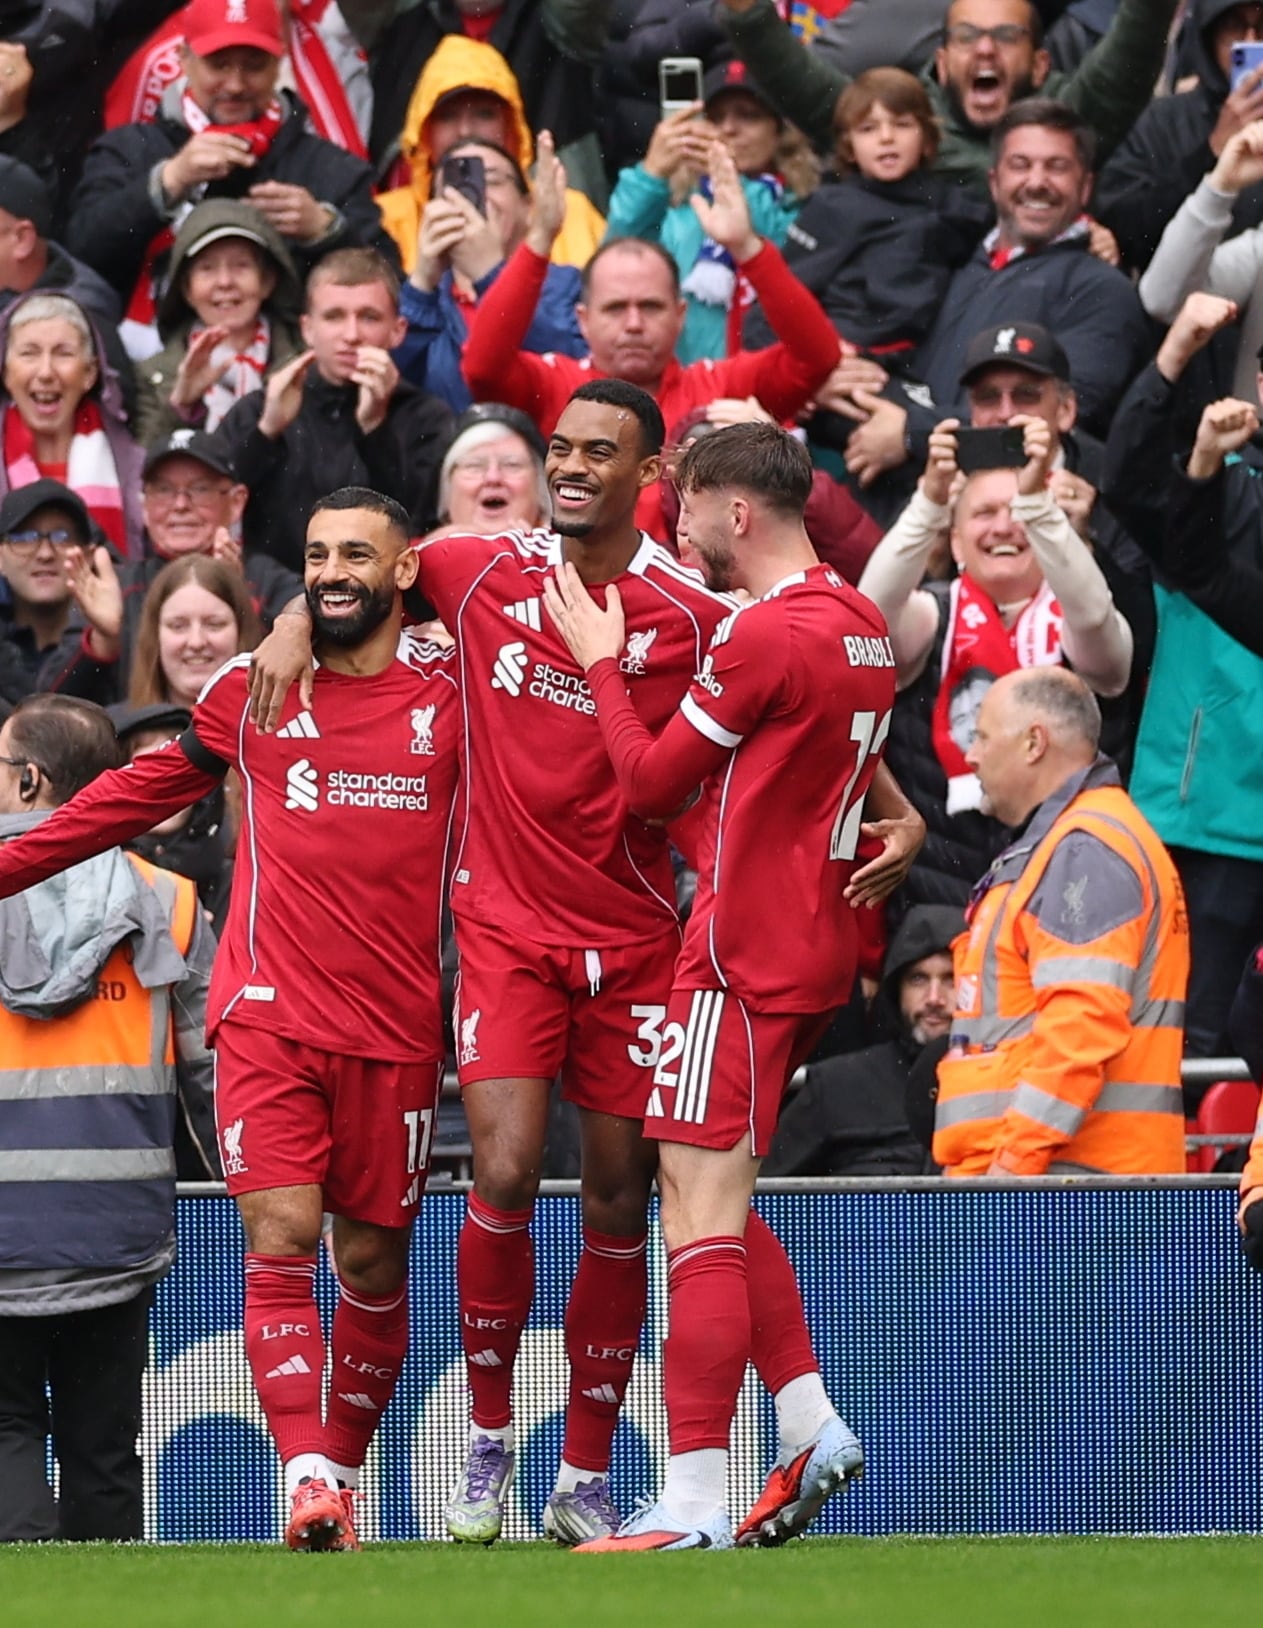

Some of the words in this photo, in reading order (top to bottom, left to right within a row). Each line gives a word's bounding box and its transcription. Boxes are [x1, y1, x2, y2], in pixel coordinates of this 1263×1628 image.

[843, 636, 895, 667] BRADL
[327, 769, 426, 793] standard
[327, 788, 428, 811] chartered
[404, 1109, 433, 1174] 11
[261, 1322, 310, 1341] LFC
[463, 1312, 507, 1332] LFC
[585, 1344, 633, 1362] LFC
[342, 1353, 393, 1381] LFC
